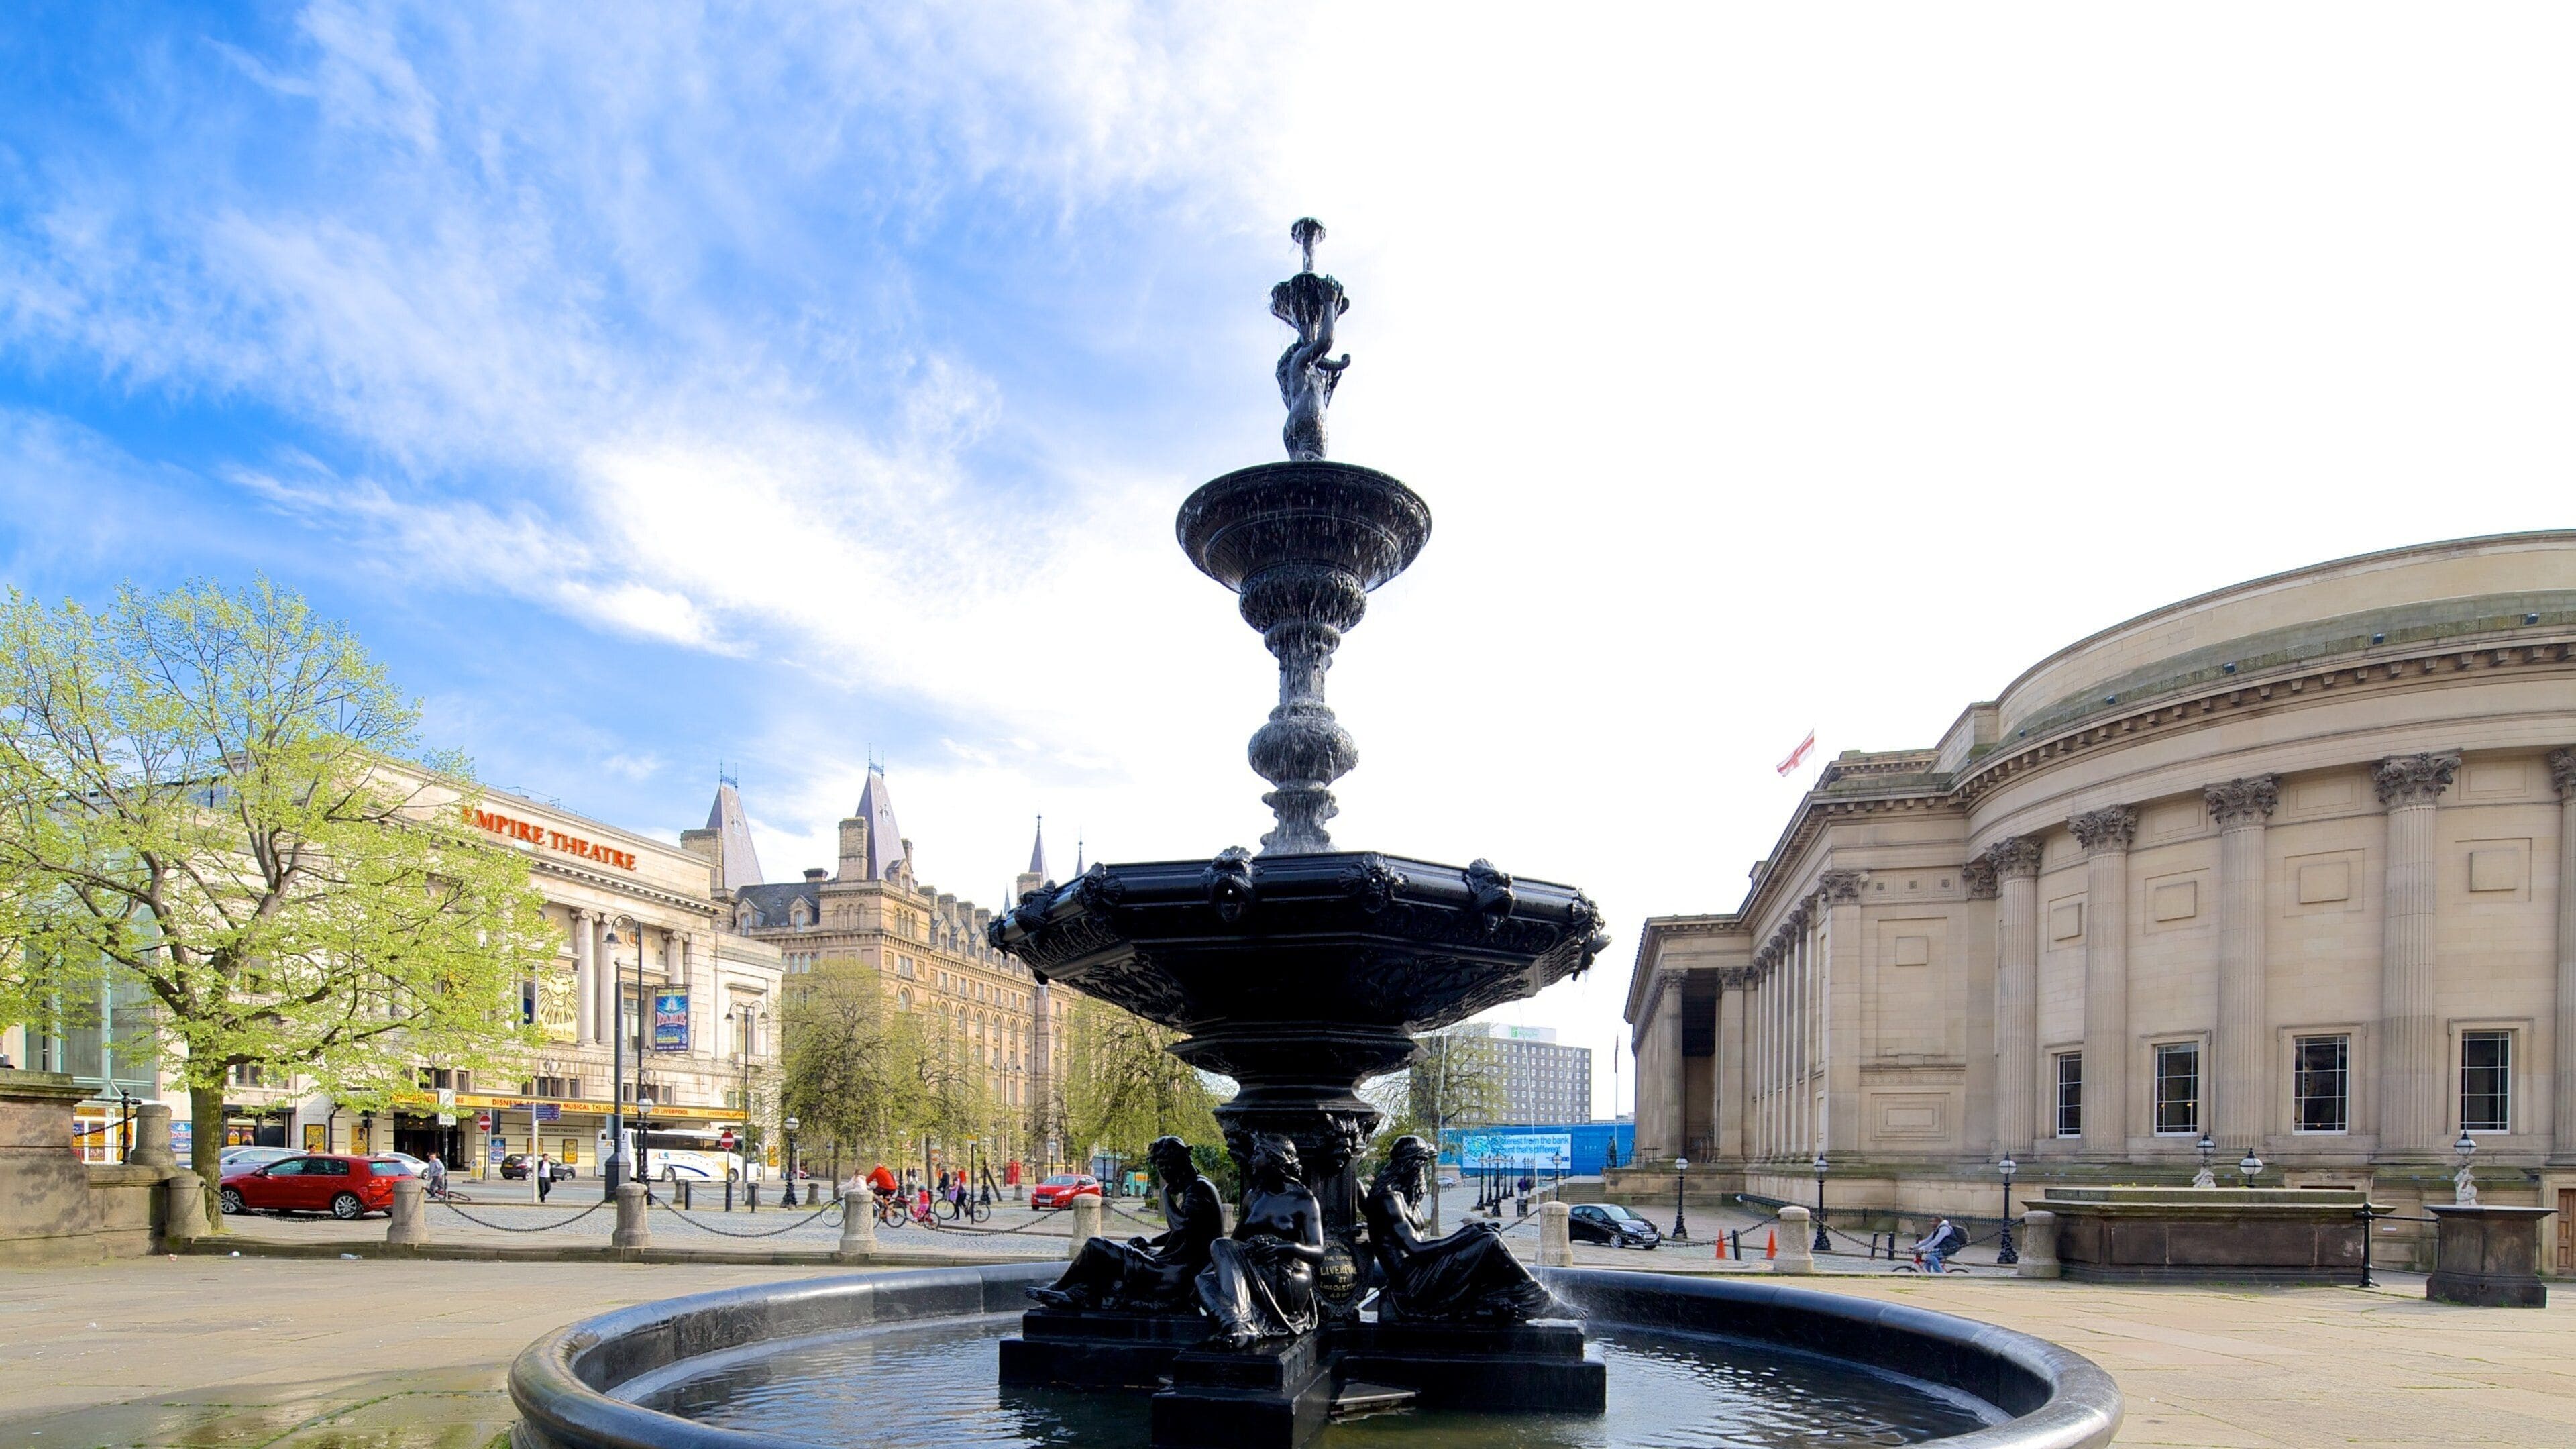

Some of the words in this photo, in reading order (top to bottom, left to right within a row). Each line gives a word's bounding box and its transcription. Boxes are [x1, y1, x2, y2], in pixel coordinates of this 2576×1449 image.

[462, 806, 545, 845] EMPIRE
[547, 830, 637, 871] THEATRE
[563, 1103, 590, 1111] MUSICAL
[1523, 1136, 1539, 1144] from
[1540, 1136, 1552, 1144] the
[1552, 1136, 1569, 1144] bank
